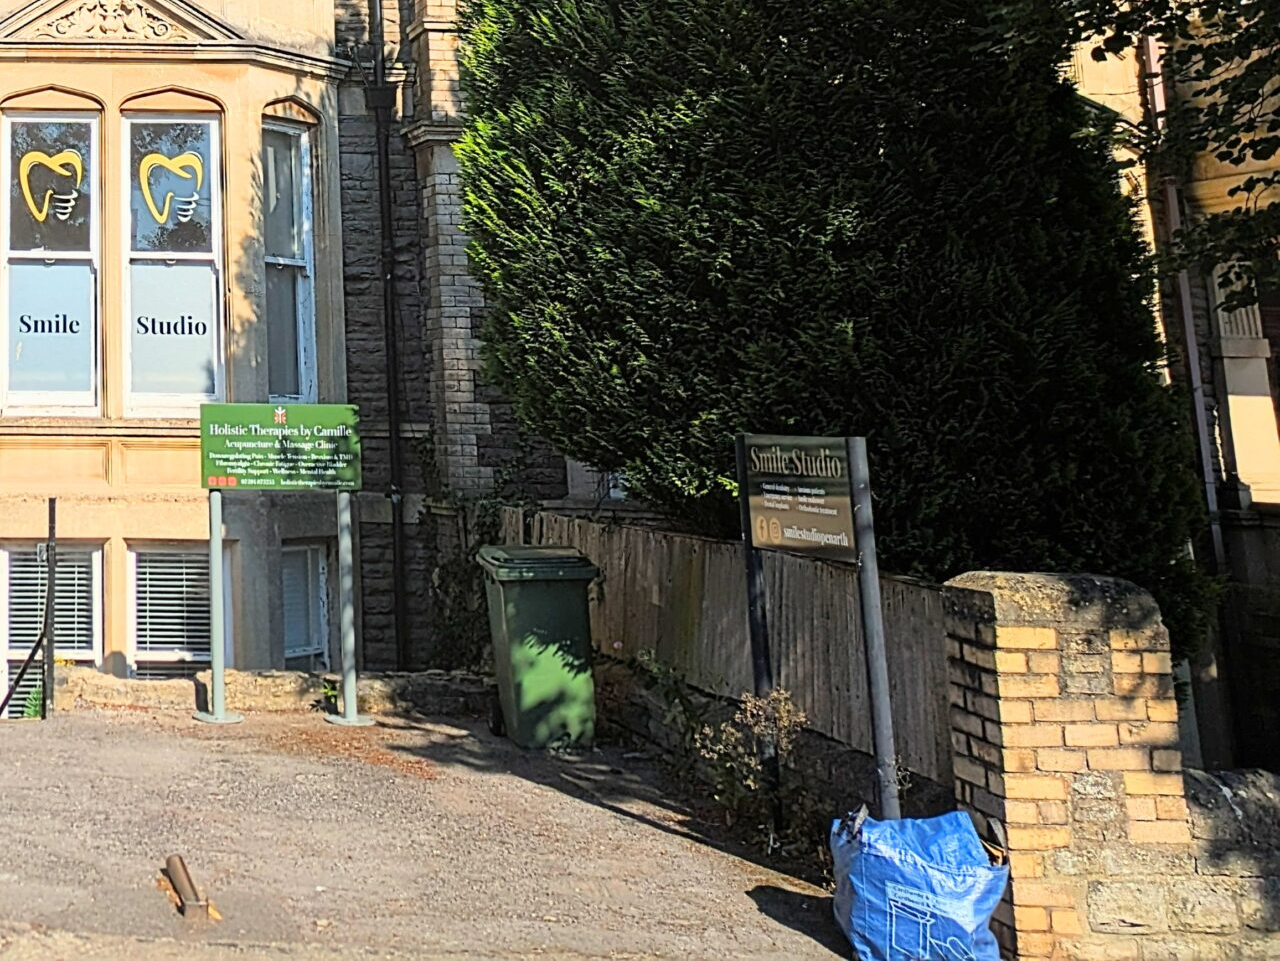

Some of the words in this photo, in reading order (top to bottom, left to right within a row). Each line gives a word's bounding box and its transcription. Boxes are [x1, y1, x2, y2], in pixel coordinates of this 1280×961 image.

[19, 314, 80, 334] Smile
[136, 315, 207, 336] Studio
[209, 423, 248, 437] Holistic
[249, 423, 299, 440] Therapies
[300, 424, 312, 440] by
[313, 424, 352, 437] Camille
[224, 439, 274, 451] Acupuncture
[274, 440, 281, 449] &
[282, 440, 314, 451] Massage
[315, 440, 338, 449] Clinic
[750, 446, 789, 475] Smile
[792, 448, 841, 479] Studio
[783, 525, 849, 547] smilestudiopenarth
